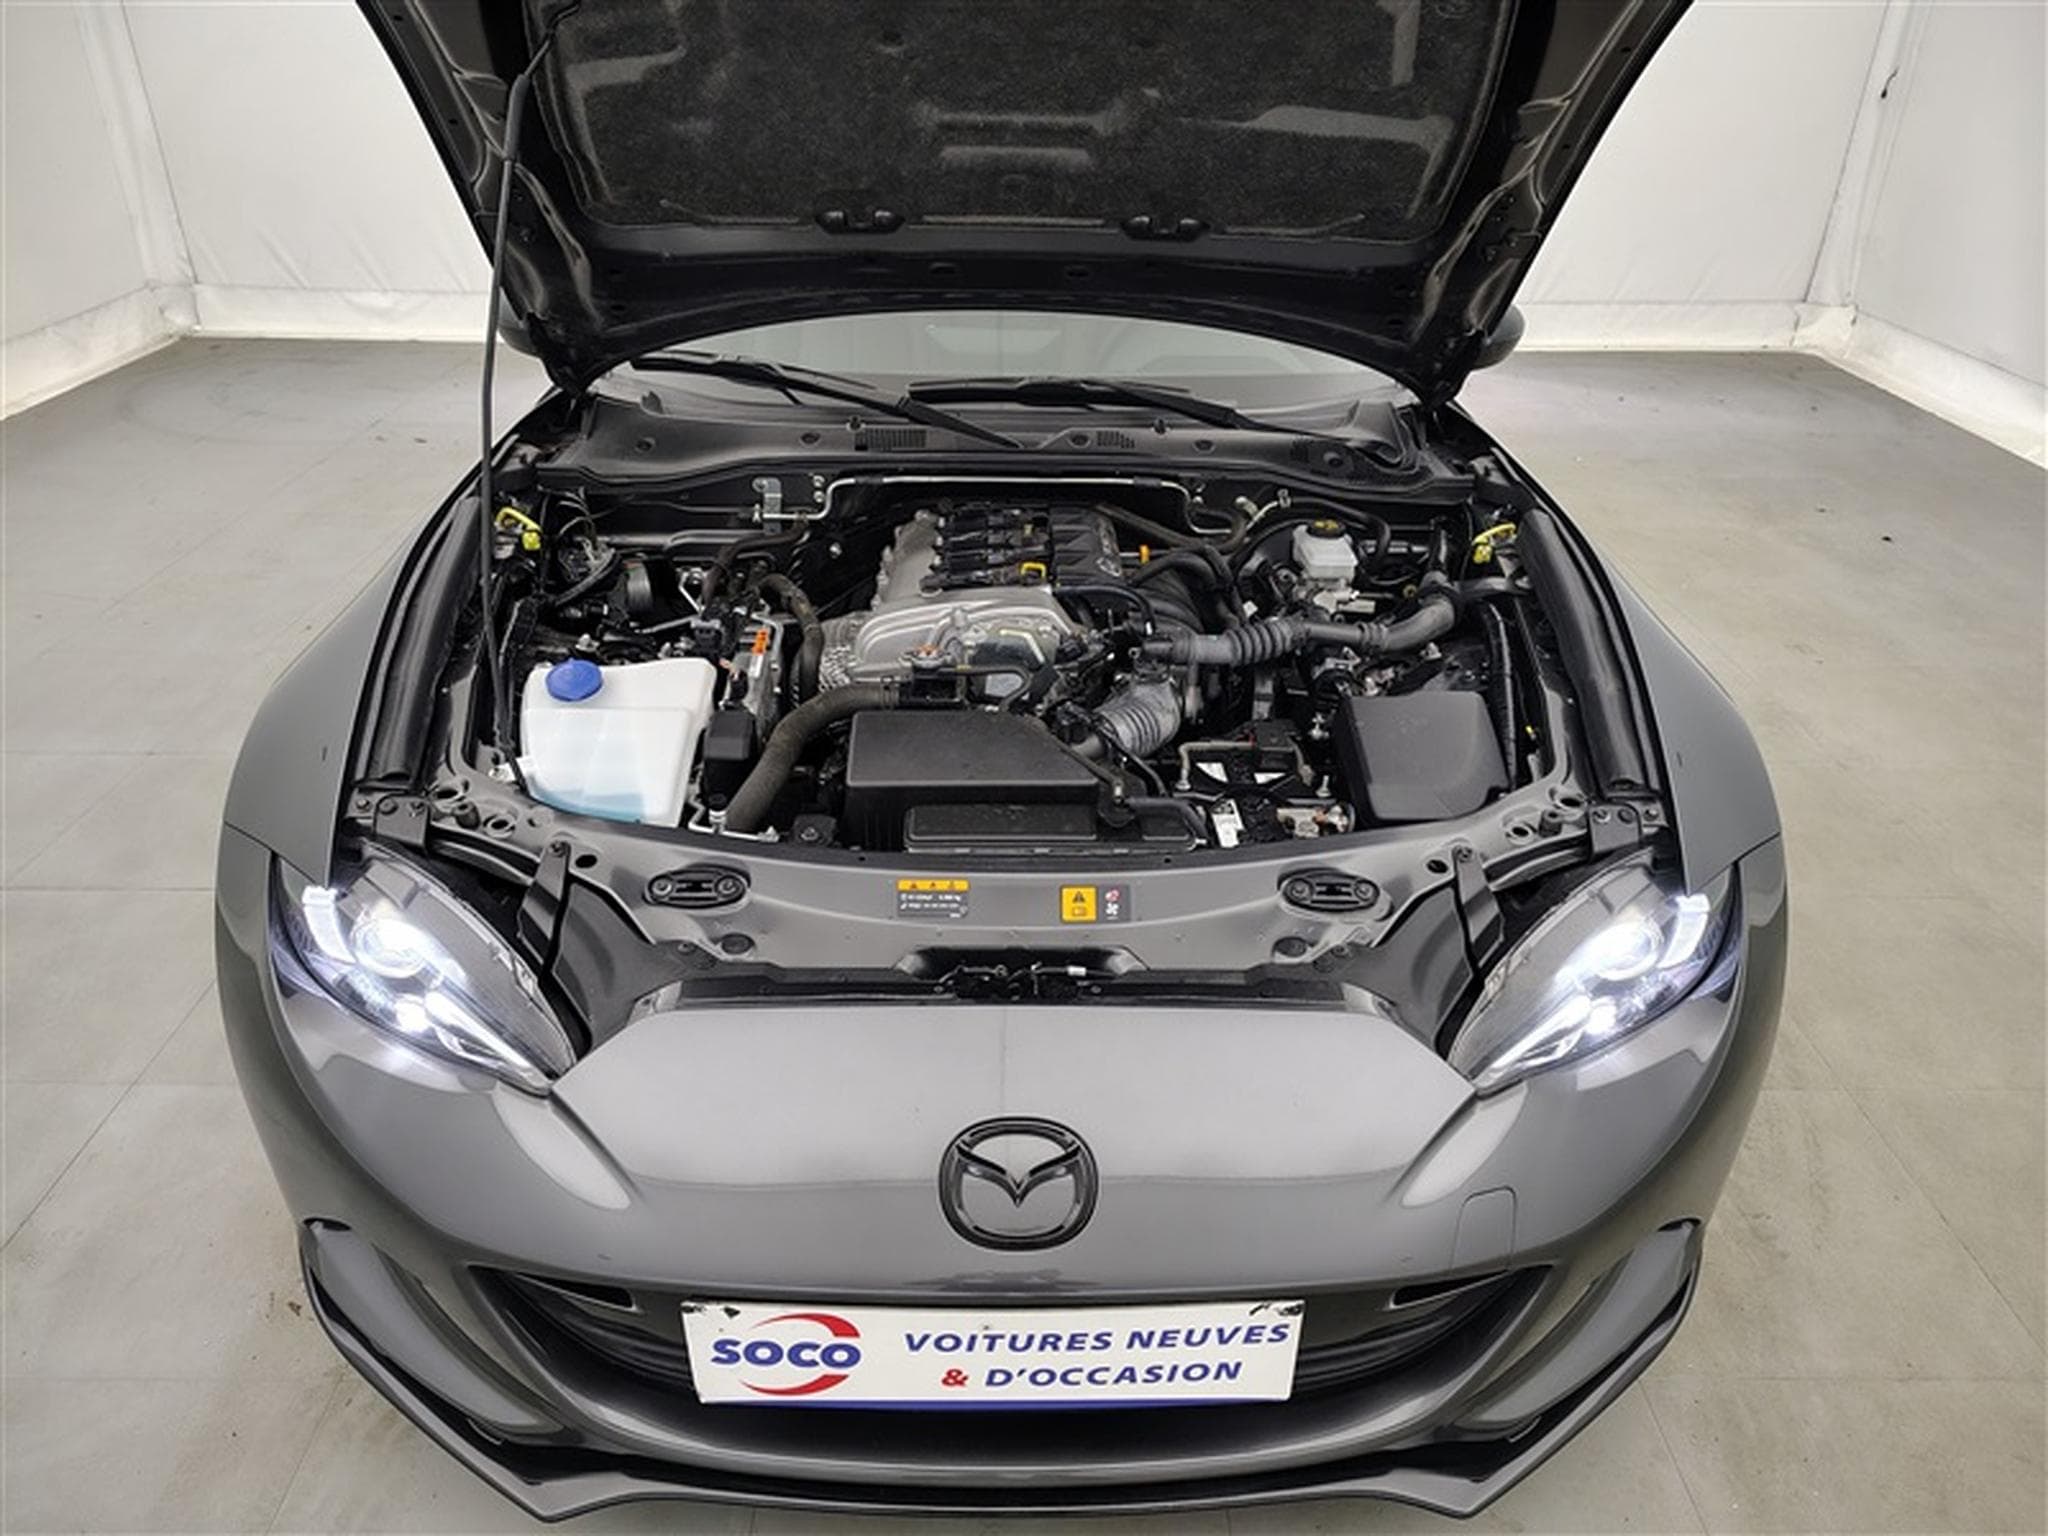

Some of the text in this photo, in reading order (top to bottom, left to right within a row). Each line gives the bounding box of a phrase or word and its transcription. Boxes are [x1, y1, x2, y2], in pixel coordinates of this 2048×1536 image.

[904, 1323, 1290, 1353] VOITURES NEUVES
[711, 1338, 862, 1370] SOCO
[940, 1361, 1243, 1388] & D'OCCASION
